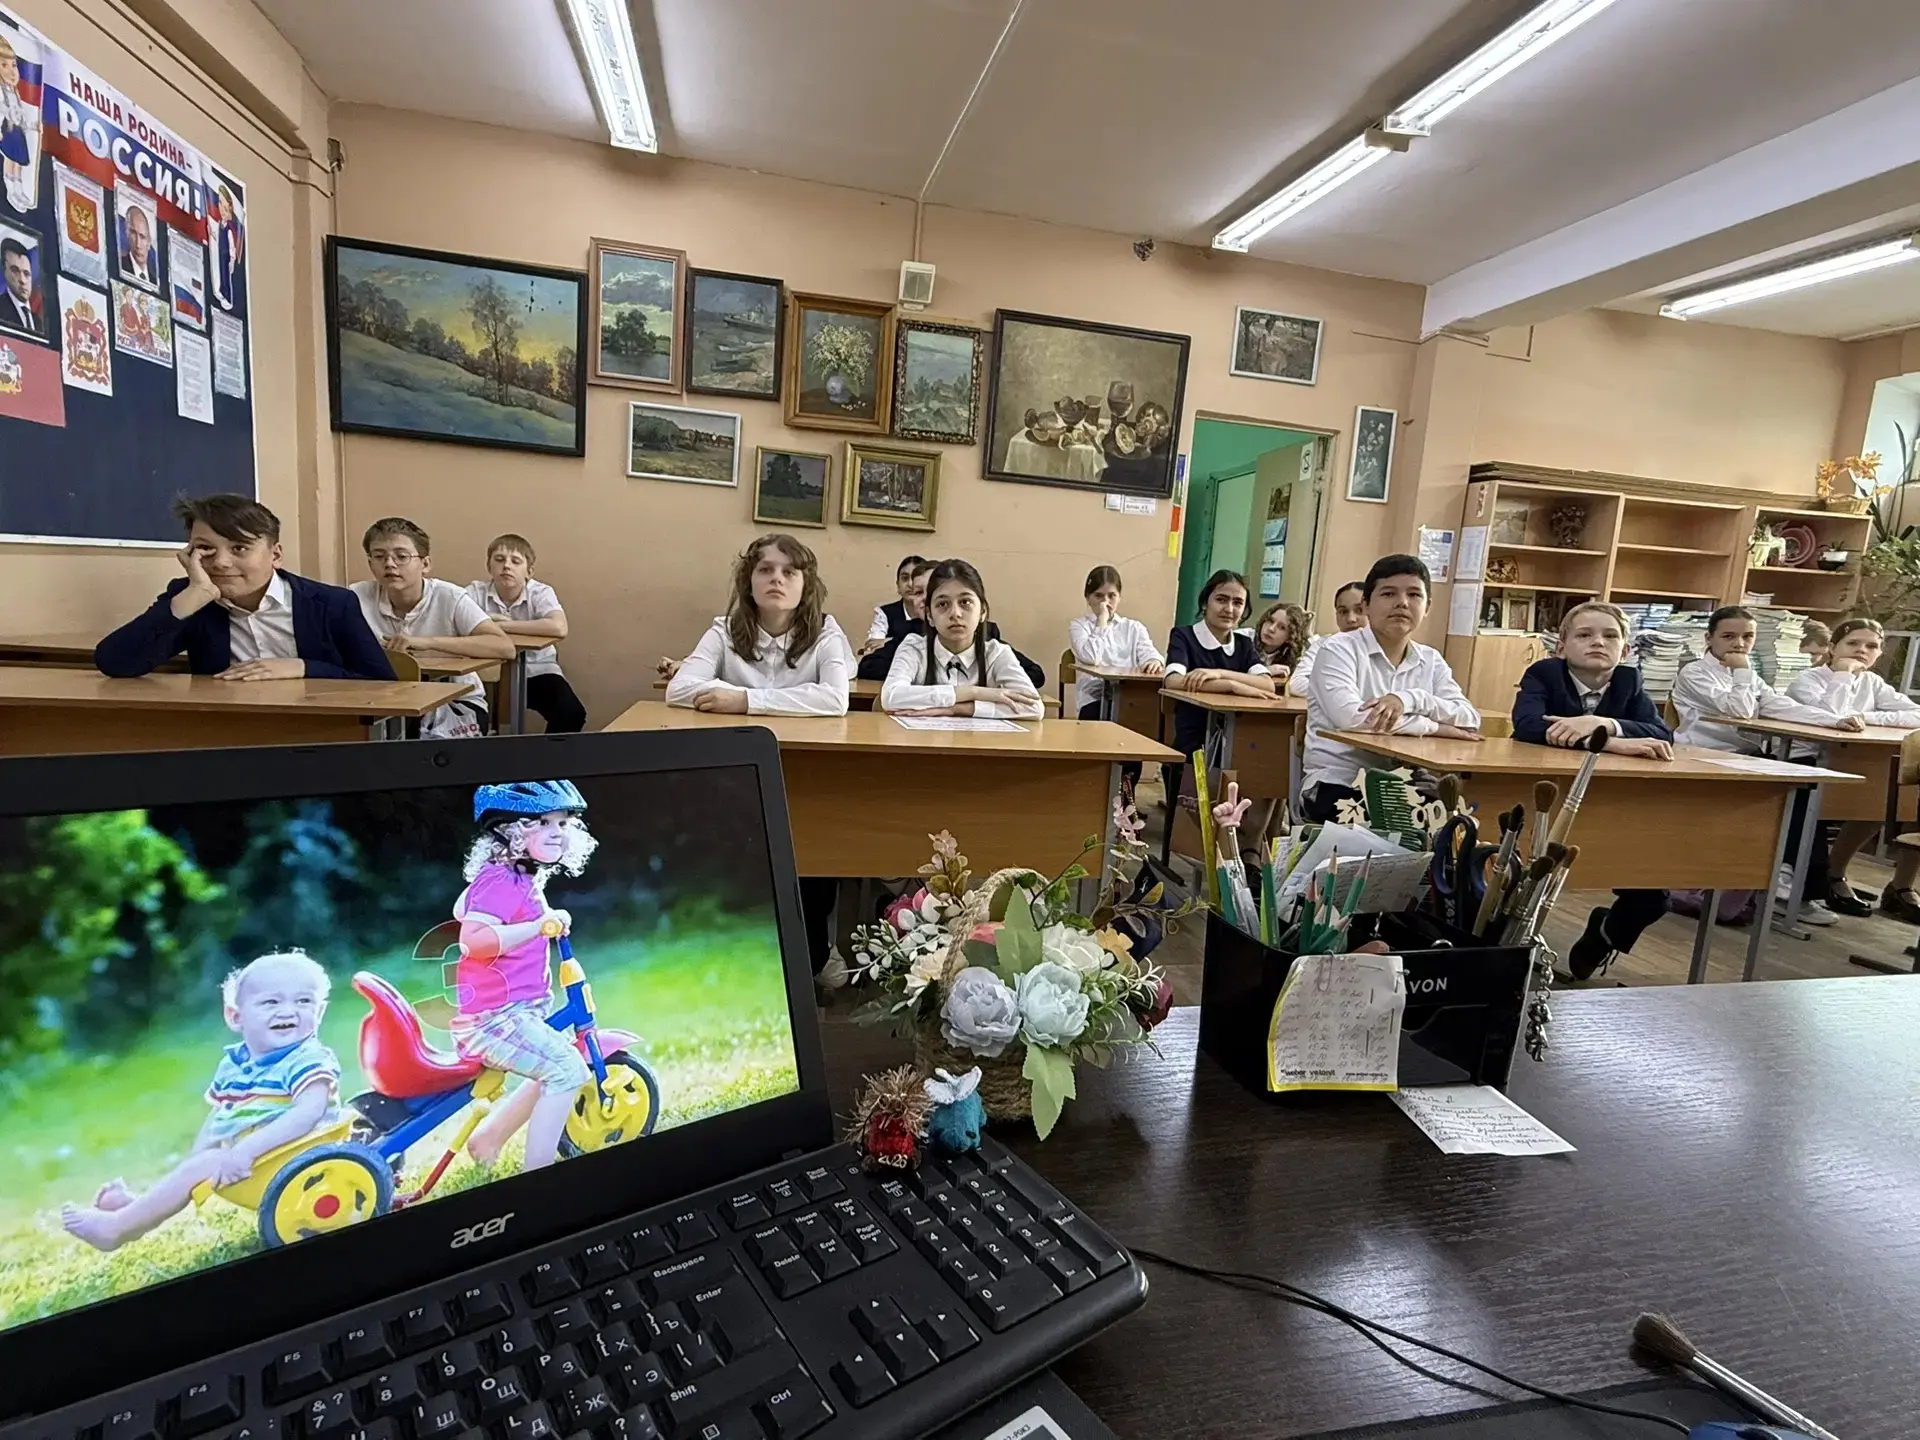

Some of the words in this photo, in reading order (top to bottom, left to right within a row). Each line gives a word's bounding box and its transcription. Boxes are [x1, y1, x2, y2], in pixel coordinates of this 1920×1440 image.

[69, 72, 122, 127] НАША
[57, 97, 202, 221] РОССИЯ!
[1404, 977, 1449, 995] VON
[970, 1180, 980, 1189] 9
[834, 1198, 853, 1209] Page
[938, 1193, 948, 1202] 8
[795, 1211, 818, 1224] Home
[903, 1206, 912, 1216] 7
[676, 1212, 695, 1224] F12
[962, 1217, 972, 1226] 5
[450, 1212, 515, 1249] acer
[632, 1228, 651, 1240] F11
[755, 1226, 780, 1239] Insert
[855, 1223, 875, 1234] Page
[860, 1228, 882, 1241] Down
[1021, 1228, 1032, 1237] 3
[930, 1232, 939, 1241] 4
[586, 1243, 605, 1255] F10
[819, 1239, 836, 1250] End
[988, 1243, 1000, 1253] 2
[652, 1254, 706, 1279] Backspace
[773, 1253, 801, 1268] Delete
[537, 1263, 551, 1273] F9
[465, 1287, 481, 1298] F8
[695, 1287, 723, 1303] Enter
[981, 1289, 993, 1299] 0
[408, 1307, 424, 1319] F7
[348, 1329, 365, 1341] F6
[284, 1351, 301, 1363] F5
[539, 1354, 551, 1367] P
[443, 1364, 456, 1377] 9
[645, 1369, 659, 1382] Э
[189, 1383, 208, 1397] F4
[380, 1388, 393, 1401] 8
[497, 1383, 519, 1400] Щ
[670, 1384, 698, 1402] Shift
[584, 1393, 605, 1411] Ж
[770, 1389, 792, 1405] Ctrl
[112, 1410, 133, 1425] F3
[312, 1415, 325, 1429] 7
[436, 1410, 456, 1429] Ш
[508, 1415, 522, 1428] L
[531, 1418, 547, 1437] Д
